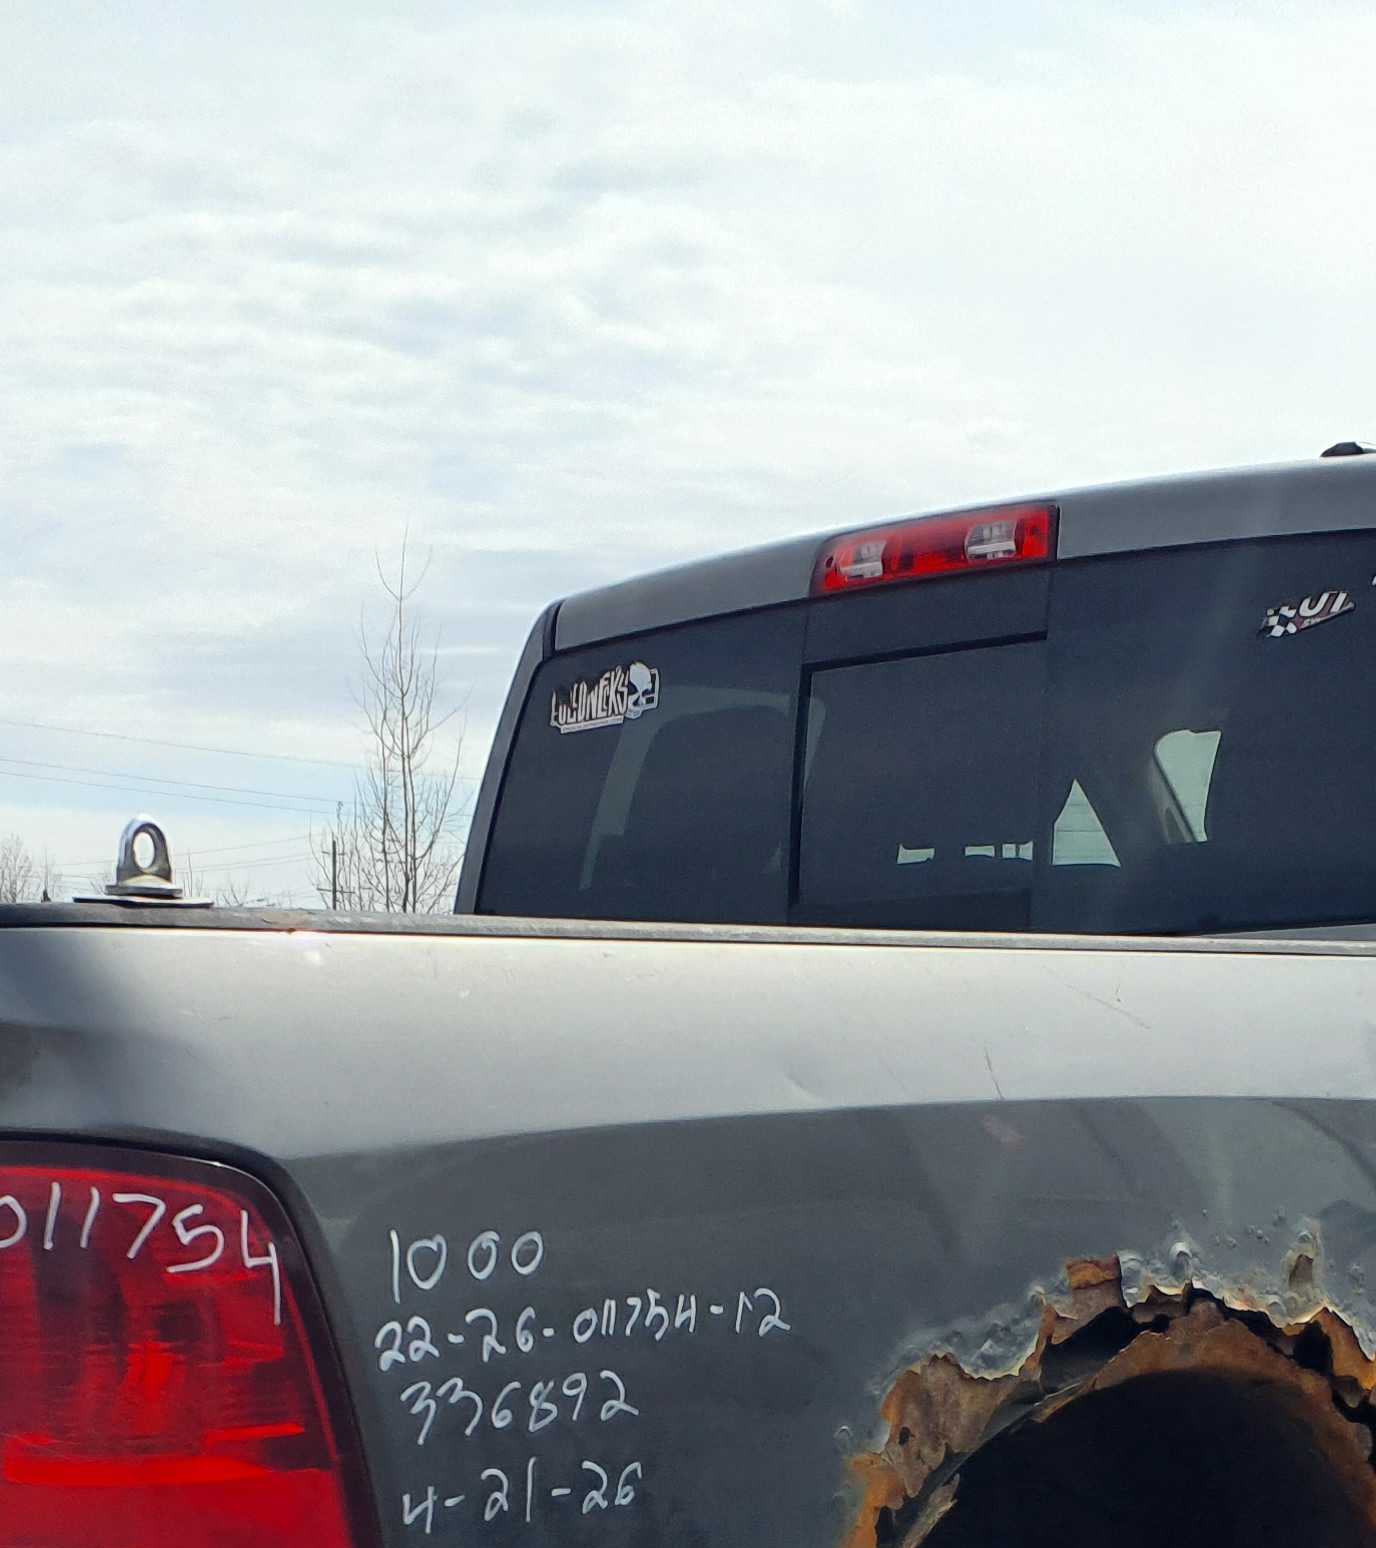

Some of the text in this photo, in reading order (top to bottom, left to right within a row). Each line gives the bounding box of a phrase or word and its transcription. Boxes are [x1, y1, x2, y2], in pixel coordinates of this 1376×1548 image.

[390, 1229, 544, 1303] 1000
[374, 1288, 791, 1371] 22-26-011754-12
[401, 1370, 640, 1445] 336892
